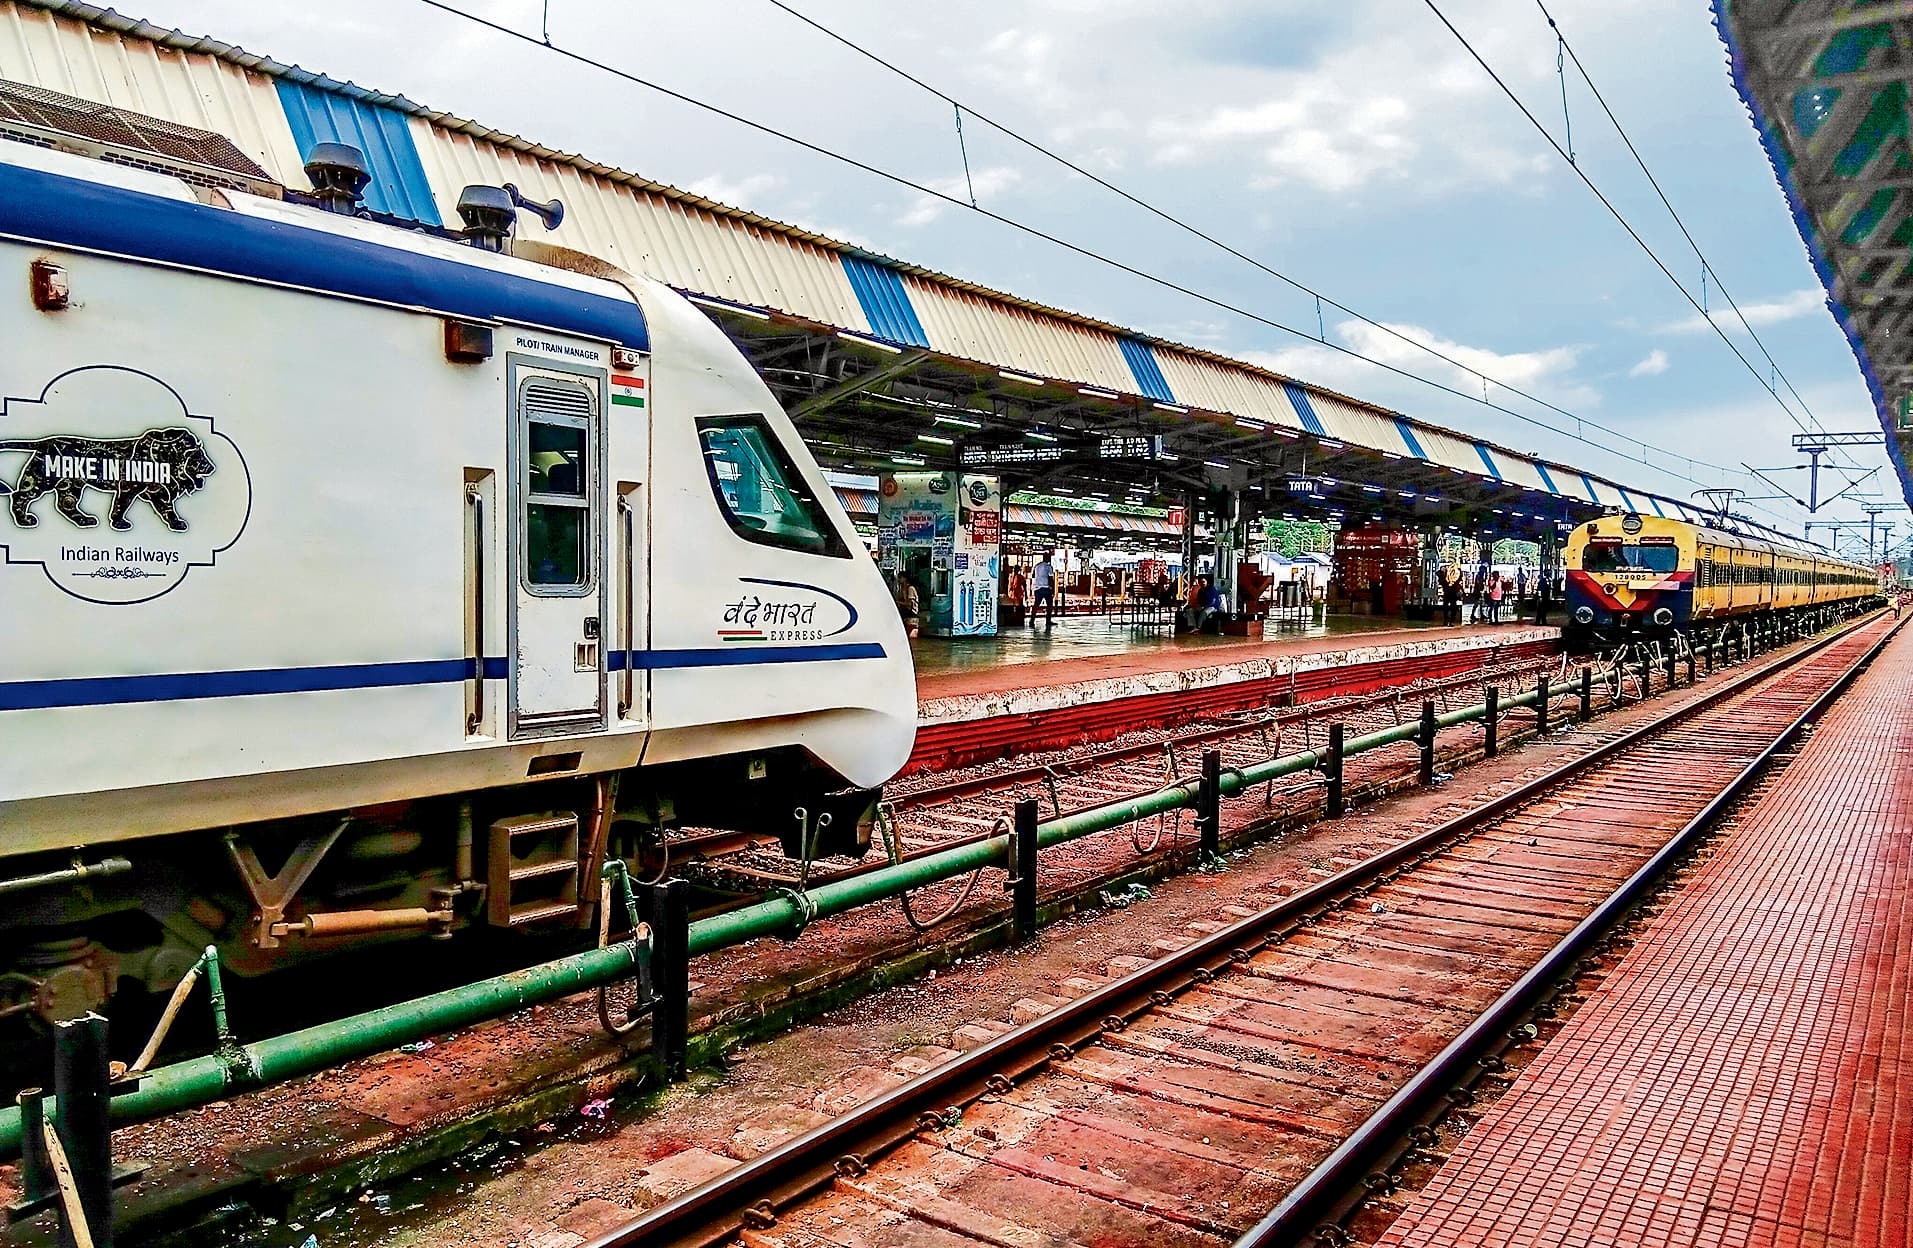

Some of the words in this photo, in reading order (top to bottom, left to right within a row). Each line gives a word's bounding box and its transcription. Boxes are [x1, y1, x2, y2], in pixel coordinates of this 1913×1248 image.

[541, 341, 563, 354] TRAIN
[564, 345, 600, 361] MANAGER
[44, 454, 99, 480] MAKE
[102, 458, 120, 481] IN
[125, 459, 171, 484] INDIA
[1288, 481, 1313, 492] TATA
[60, 545, 111, 562] Indian
[115, 546, 179, 566] Railways
[723, 595, 762, 628] वंदे
[763, 601, 817, 627] भारत
[770, 630, 823, 641] EXPRESS
